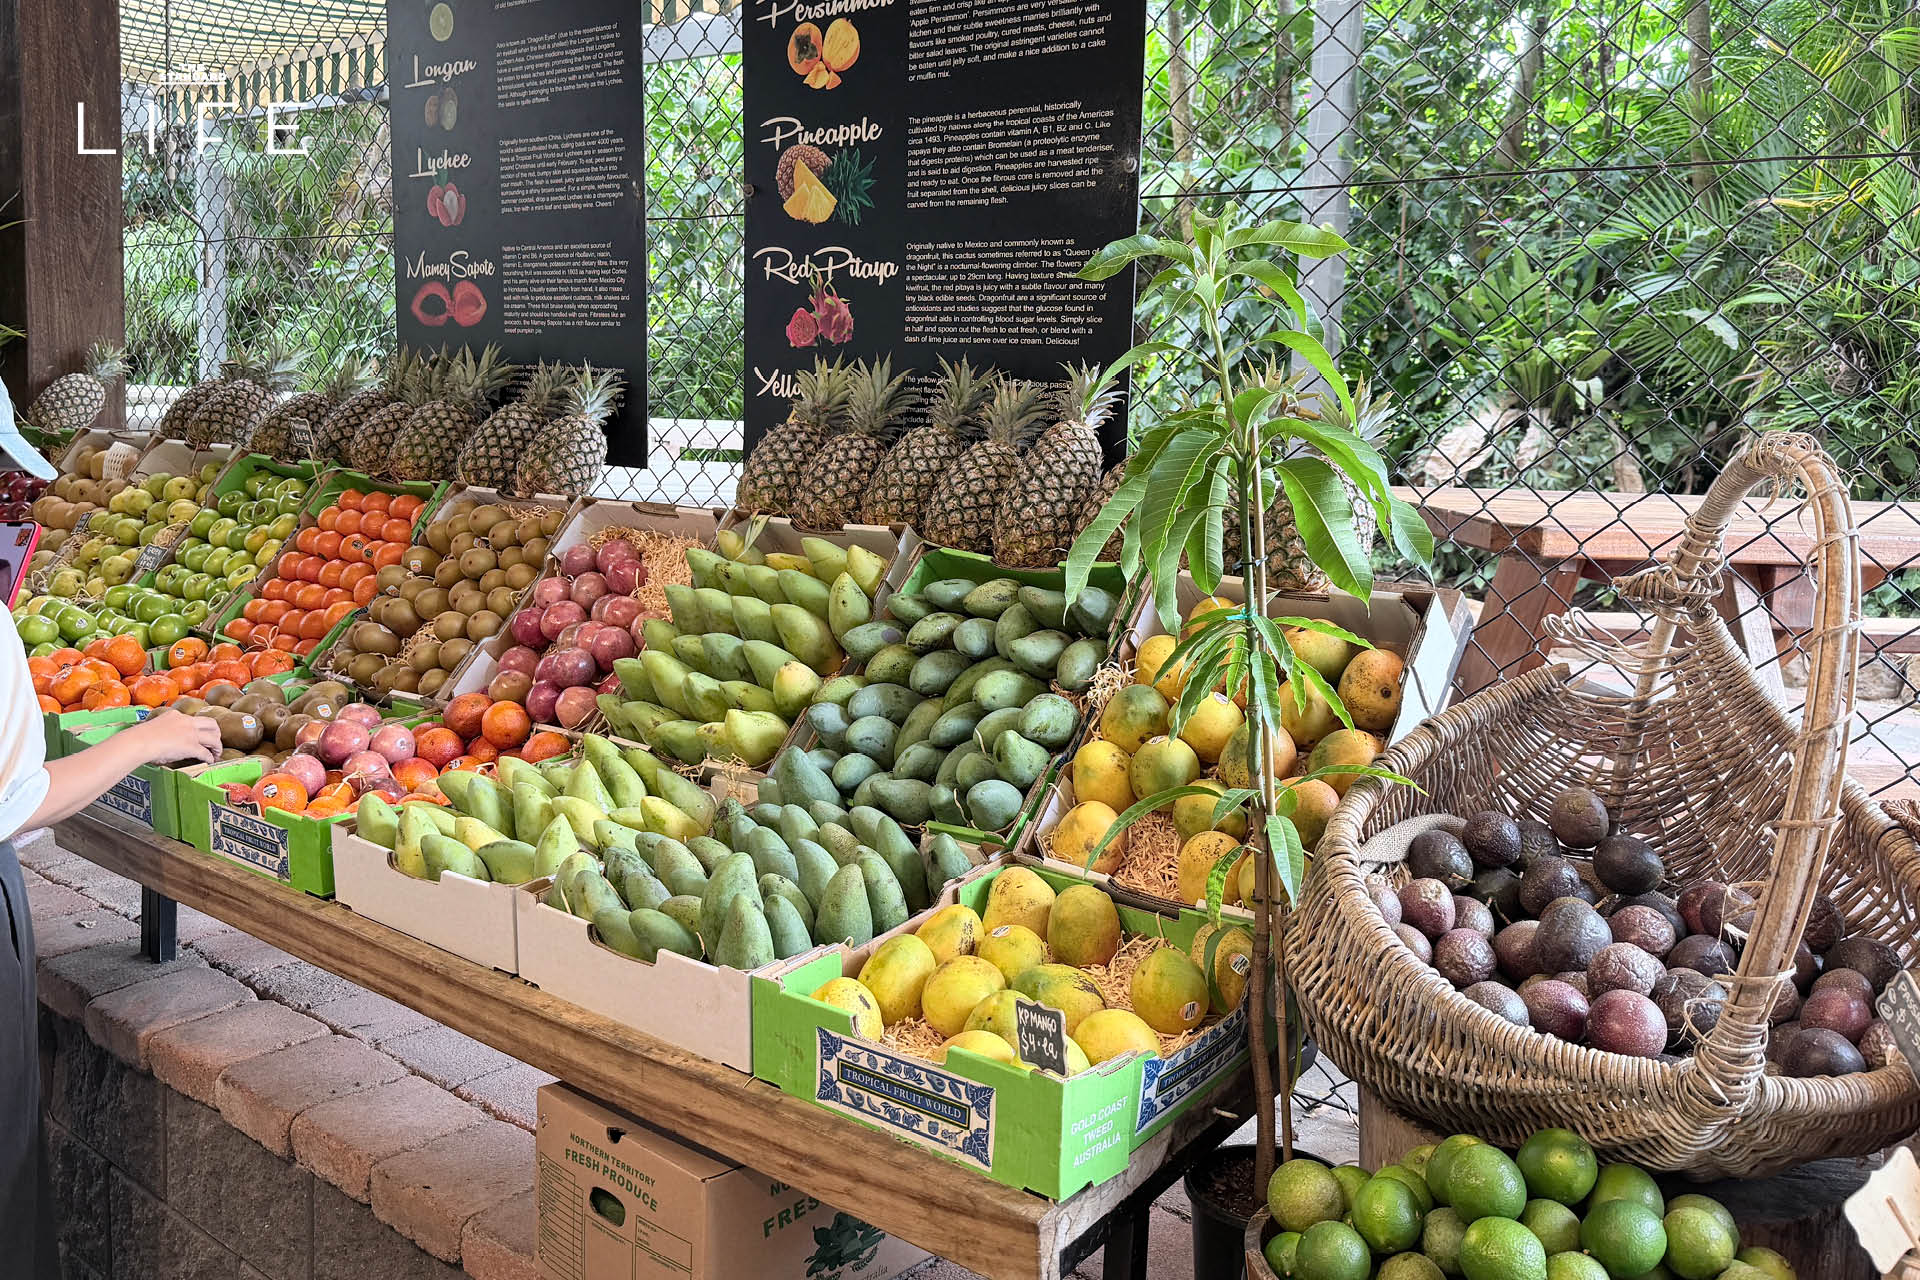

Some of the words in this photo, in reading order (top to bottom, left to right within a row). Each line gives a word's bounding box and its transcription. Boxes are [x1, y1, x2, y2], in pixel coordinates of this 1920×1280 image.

[908, 26, 931, 38] kitchen
[933, 24, 945, 34] and
[946, 22, 961, 32] their
[963, 19, 983, 30] subtle
[984, 13, 1021, 27] sweetness
[1022, 9, 1049, 21] marries
[1051, 4, 1082, 19] brilliantly
[1084, 1, 1099, 12] with
[908, 37, 933, 49] flavours
[934, 35, 946, 45] like
[947, 31, 974, 43] smoked
[1001, 25, 1021, 36] cured
[1078, 14, 1094, 25] nuts
[1096, 12, 1111, 22] and
[908, 61, 917, 71] be
[918, 59, 936, 69] eaten
[937, 57, 951, 67] until
[952, 55, 965, 67] jelly
[982, 51, 996, 61] and
[997, 48, 1016, 59] make
[1024, 45, 1039, 56] nice
[1041, 41, 1069, 53] addition
[1071, 40, 1079, 50] to
[1087, 37, 1105, 47] cake
[404, 54, 476, 89] Longan
[916, 70, 936, 80] muffin
[909, 115, 920, 124] The
[921, 112, 952, 125] pineapple
[954, 111, 959, 120] is
[967, 106, 1006, 118] herbaceous
[1044, 99, 1081, 113] historically
[760, 116, 882, 151] Pineapple
[907, 135, 922, 145] circa
[943, 130, 979, 144] Pineapples
[980, 128, 1005, 138] contain
[1007, 126, 1031, 136] vitamin
[1056, 122, 1066, 131] B2
[1068, 121, 1082, 130] and
[1094, 118, 1110, 128] Like
[907, 147, 930, 158] papaya
[932, 144, 945, 156] they
[947, 143, 961, 152] also
[962, 141, 986, 151] contain
[987, 138, 1022, 149] Bromelain
[1023, 137, 1031, 148] (a
[1032, 134, 1069, 147] proteolytic
[1070, 133, 1099, 144] enzyme
[409, 147, 472, 178] Lychee
[906, 199, 928, 208] carved
[929, 198, 943, 207] from
[945, 197, 955, 206] the
[956, 196, 989, 208] remaining
[906, 241, 934, 252] Originally
[936, 240, 955, 248] native
[956, 240, 963, 248] to
[964, 239, 988, 248] Mexico
[989, 238, 1002, 247] and
[1003, 237, 1039, 249] commonly
[1040, 237, 1063, 245] known
[405, 250, 450, 282] Mamey
[450, 250, 496, 279] Sapote
[753, 247, 813, 285] Red
[814, 246, 899, 286] Pitaya
[905, 262, 915, 270] the
[937, 262, 942, 270] is
[1041, 259, 1054, 267] The
[1056, 258, 1081, 267] flowers
[904, 313, 937, 324] dragonfruit
[938, 314, 952, 322] aids
[953, 314, 959, 322] in
[960, 314, 993, 324] controlling
[995, 314, 1014, 322] blood
[1015, 316, 1034, 324] sugar
[1060, 314, 1084, 324] Simply
[1086, 314, 1102, 322] slice
[904, 334, 919, 342] dash
[920, 334, 927, 342] of
[928, 334, 941, 342] lime
[942, 334, 957, 345] juice
[958, 334, 971, 343] and
[1008, 335, 1018, 343] ice
[1045, 336, 1079, 344] Delicious!
[753, 366, 804, 398] Yello
[917, 376, 937, 384] yellow
[1018, 1006, 1030, 1026] KP
[1030, 1011, 1057, 1037] MANGO
[846, 1068, 891, 1095] TROPICAL
[894, 1087, 924, 1104] FRUIT
[924, 1096, 961, 1119] WORLD
[1071, 1113, 1097, 1136] GOLD
[1098, 1095, 1128, 1121] COAST
[1083, 1119, 1113, 1145] TWEED
[570, 1132, 609, 1161] NORTHERN
[611, 1156, 656, 1187] TERRITORY
[1073, 1131, 1121, 1168] AUSTRALIA
[565, 1148, 600, 1172] FRESH
[602, 1164, 658, 1212] PRODUCE
[762, 1199, 820, 1238] FRES
